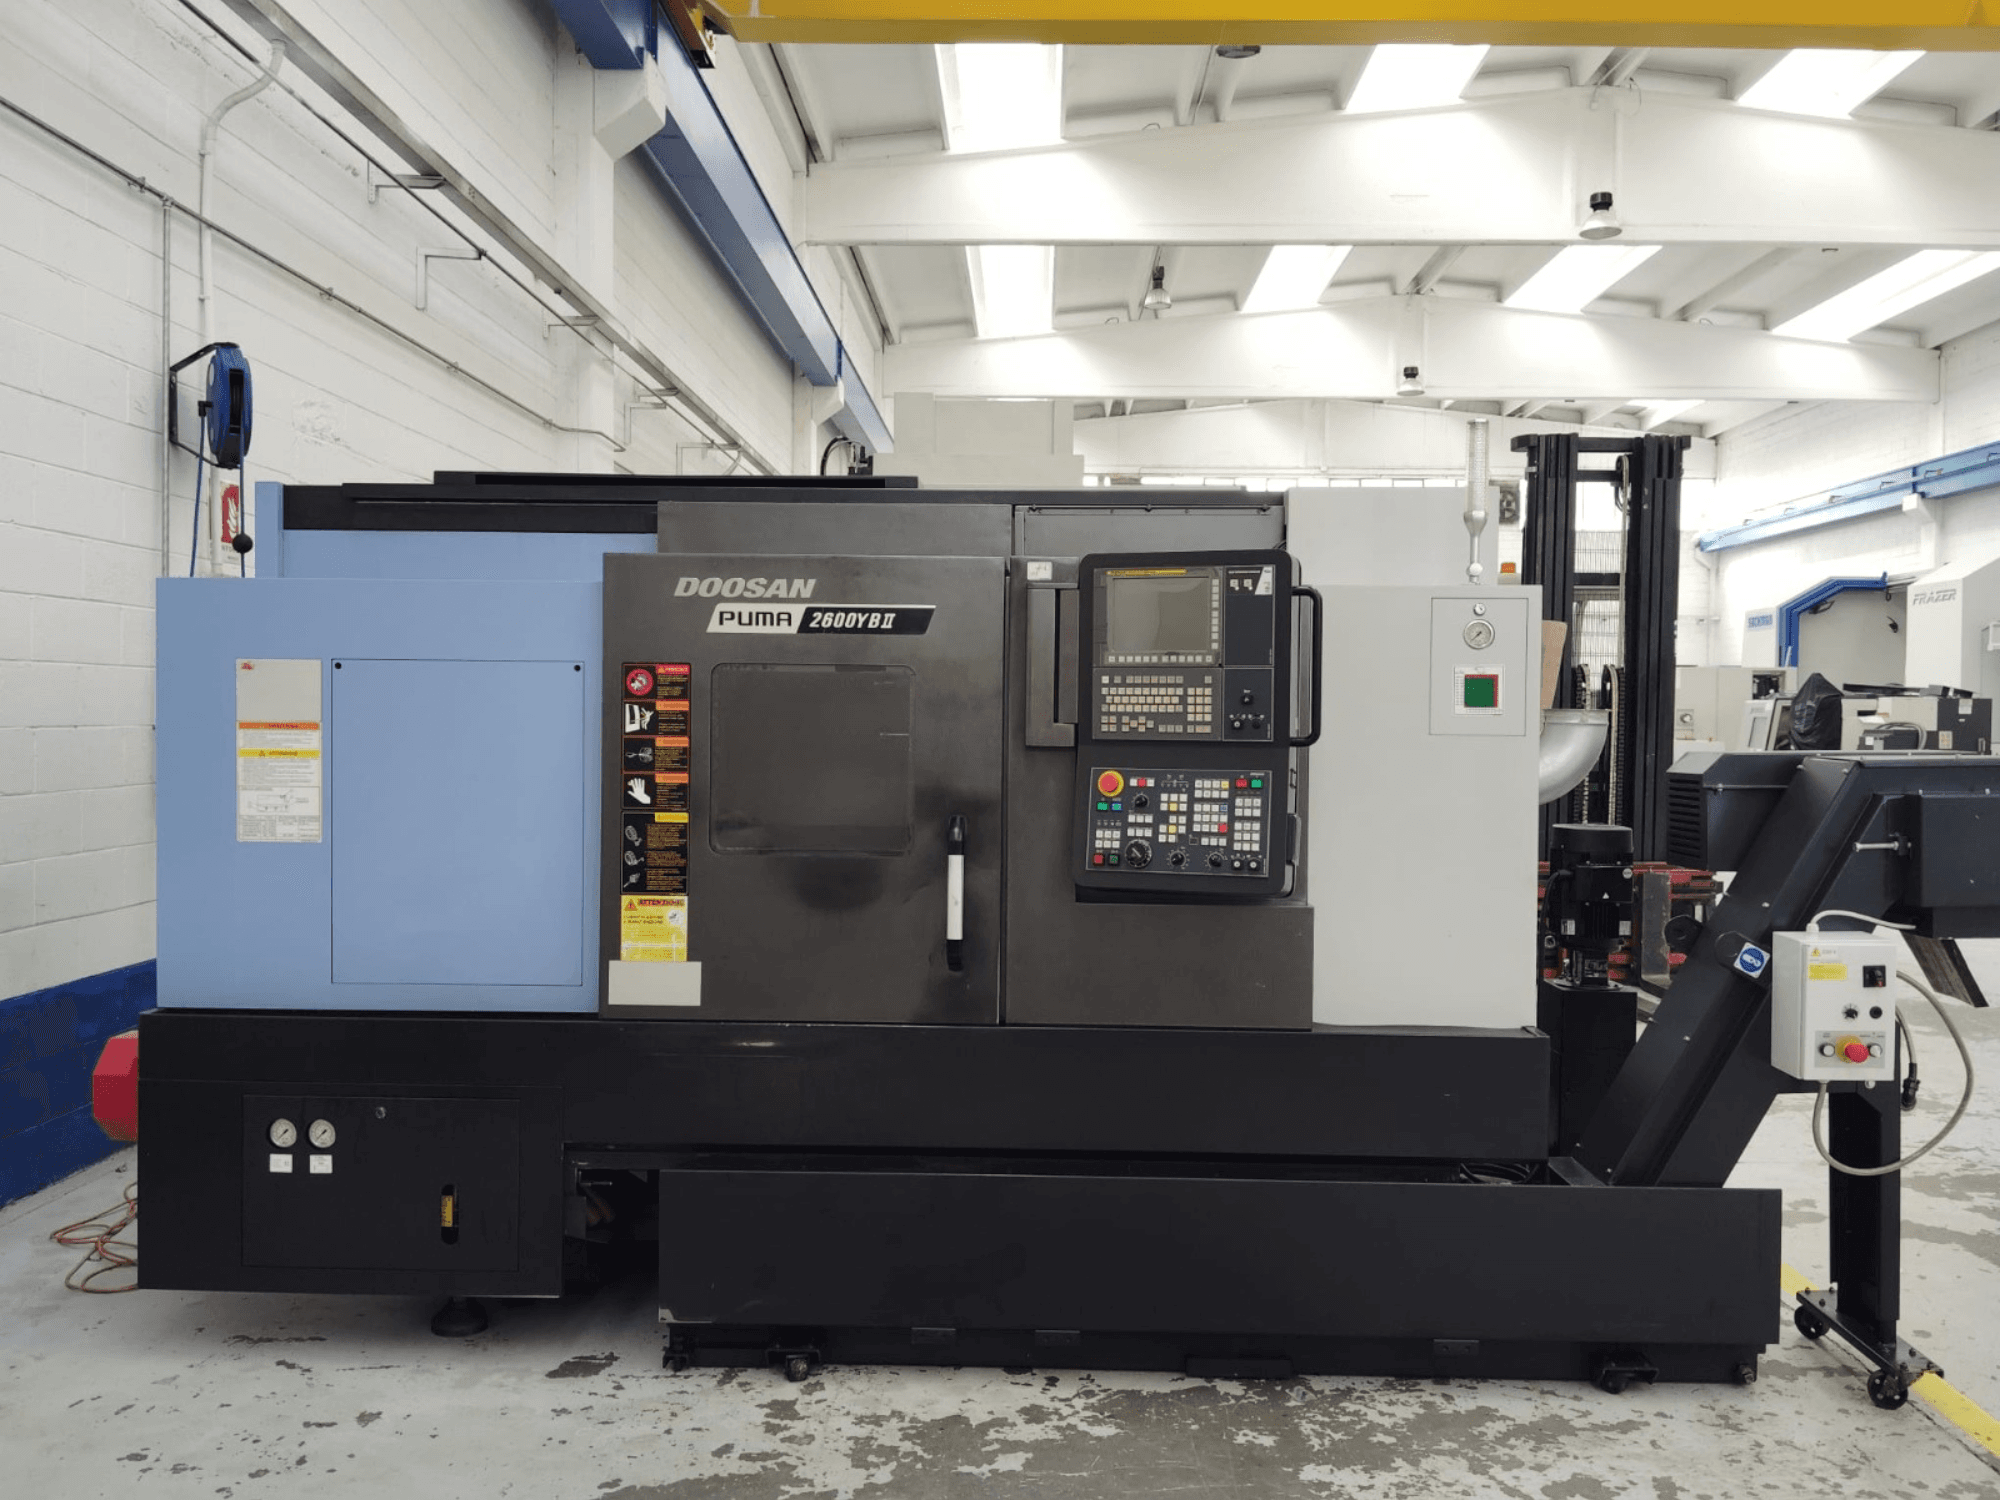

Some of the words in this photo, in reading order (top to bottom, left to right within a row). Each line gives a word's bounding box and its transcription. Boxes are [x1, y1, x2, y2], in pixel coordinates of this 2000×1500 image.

[674, 577, 817, 598] DOOSAN
[1912, 588, 1957, 606] FRAZER
[719, 611, 792, 627] PUMA
